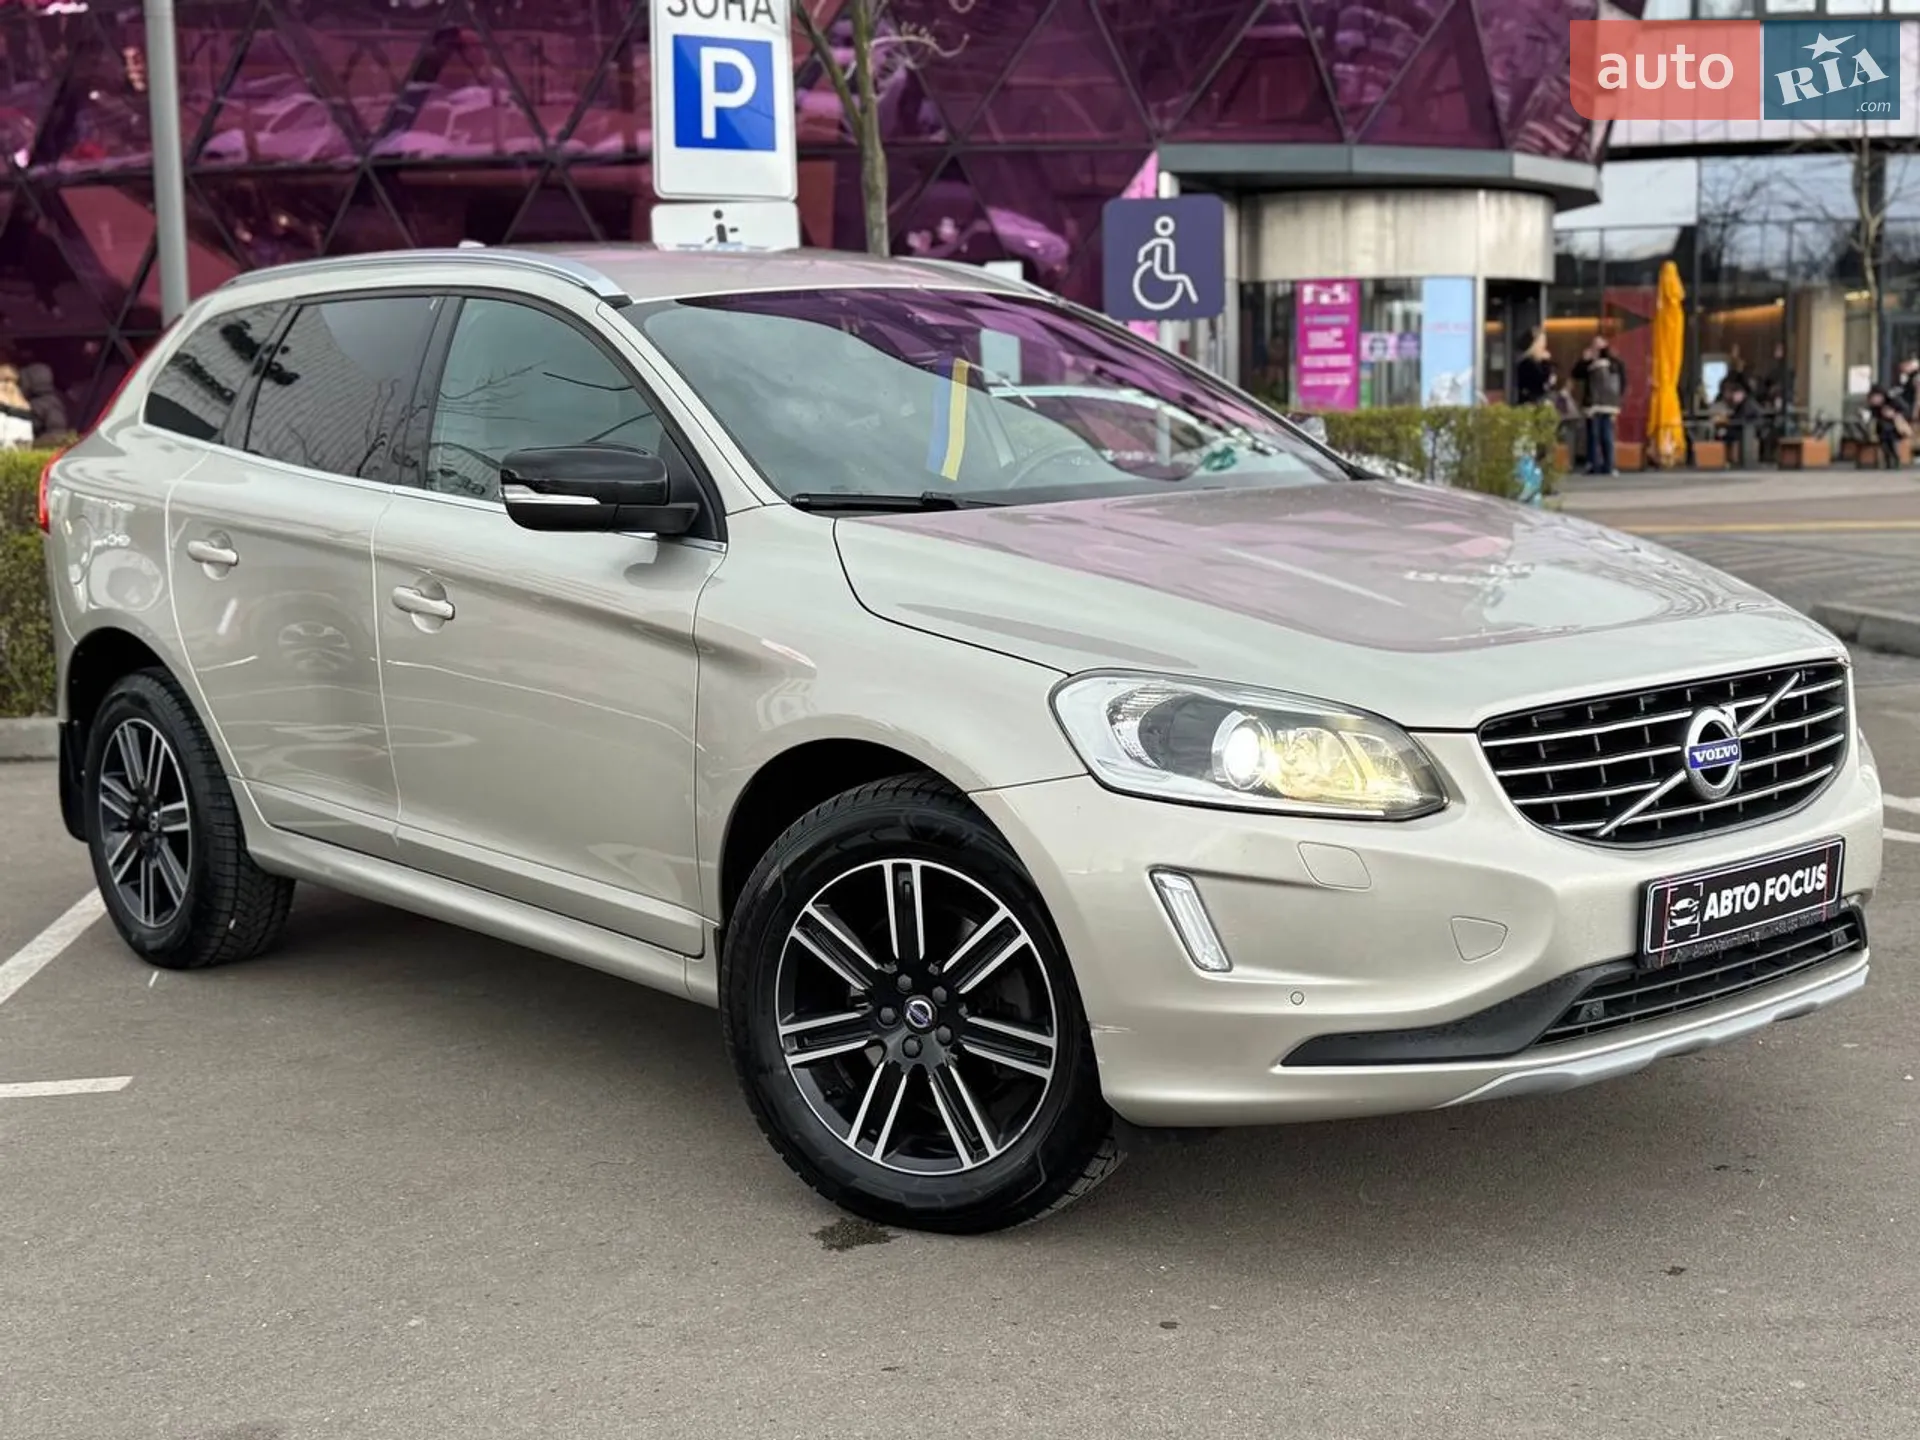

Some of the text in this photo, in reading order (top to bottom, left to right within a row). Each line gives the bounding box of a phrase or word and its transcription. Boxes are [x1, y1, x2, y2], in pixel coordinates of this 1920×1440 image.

[700, 46, 757, 139] P
[1692, 744, 1738, 763] VOLVO
[1764, 863, 1827, 906] FOCUS
